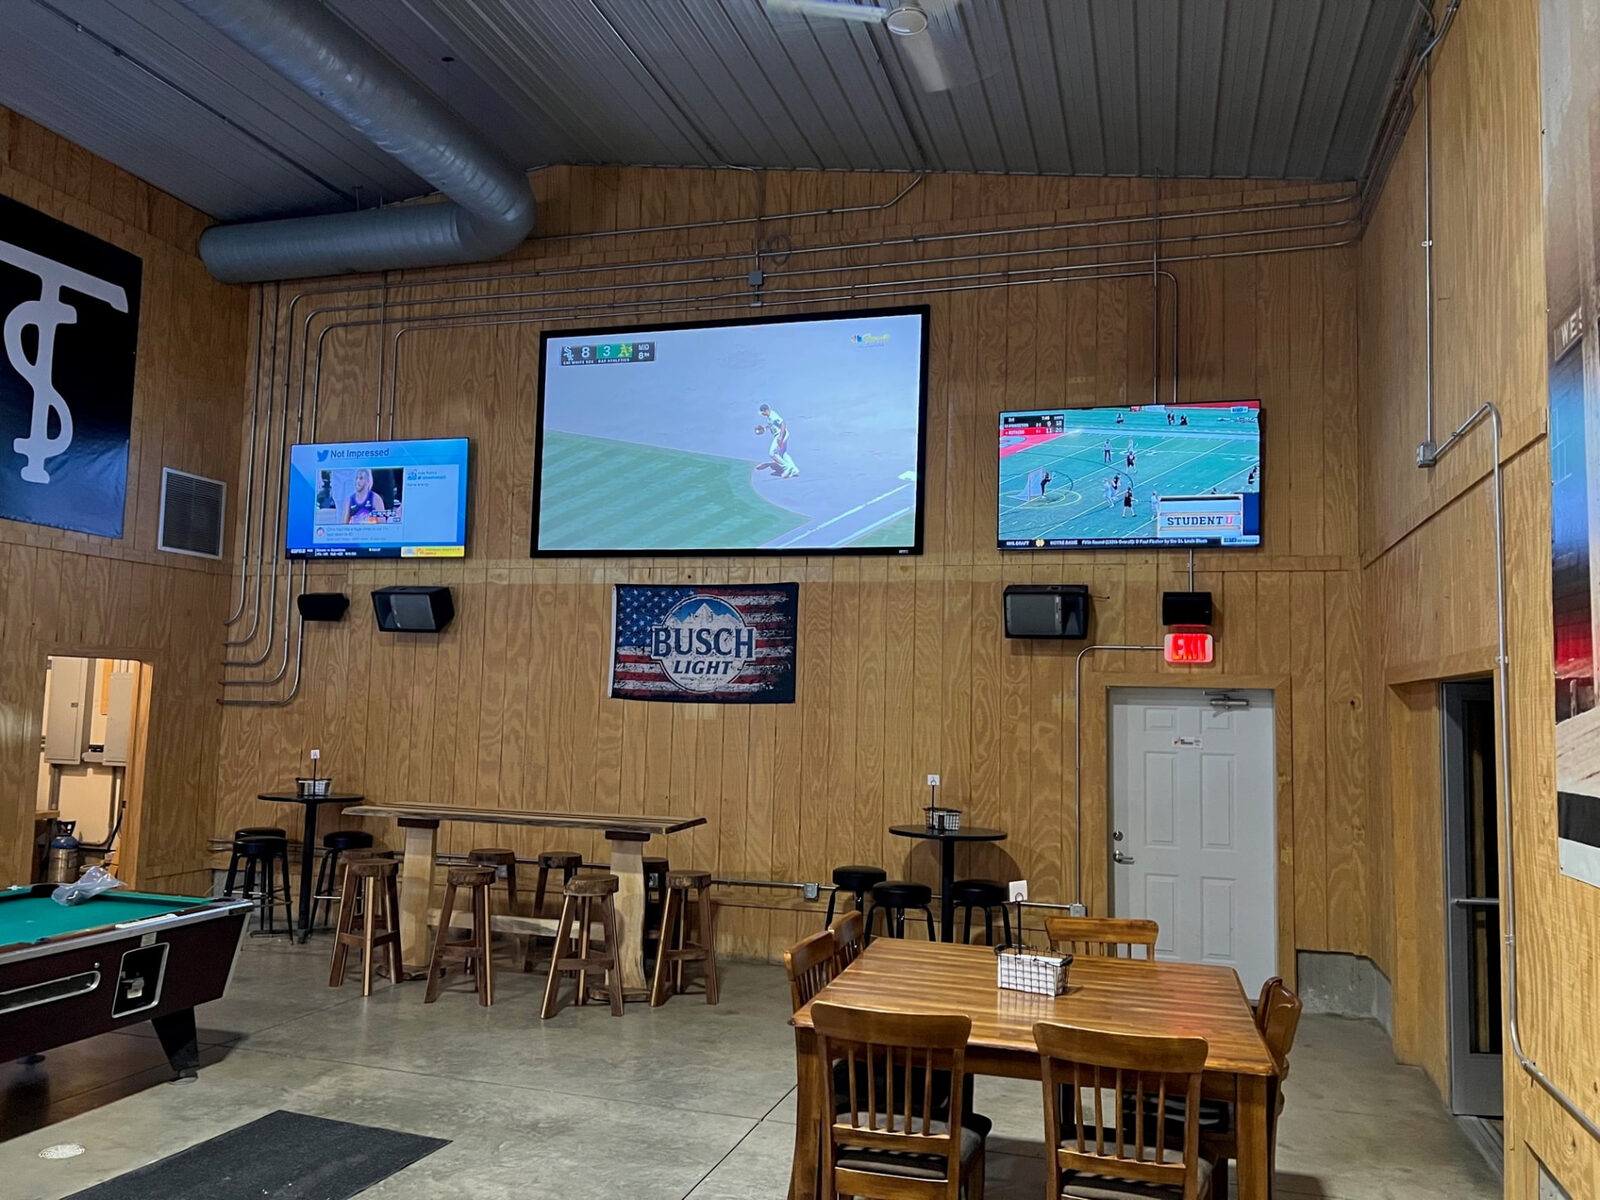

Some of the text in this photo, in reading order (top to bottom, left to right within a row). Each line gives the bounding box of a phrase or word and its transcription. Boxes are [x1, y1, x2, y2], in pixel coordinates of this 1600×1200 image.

[581, 346, 590, 358] 8
[603, 345, 611, 357] 3
[330, 448, 389, 460] Not Impressed
[1167, 515, 1224, 526] STUDENT
[653, 627, 754, 658] BUSCH
[1172, 634, 1208, 660] EXIT
[673, 660, 733, 675] LIGHT
